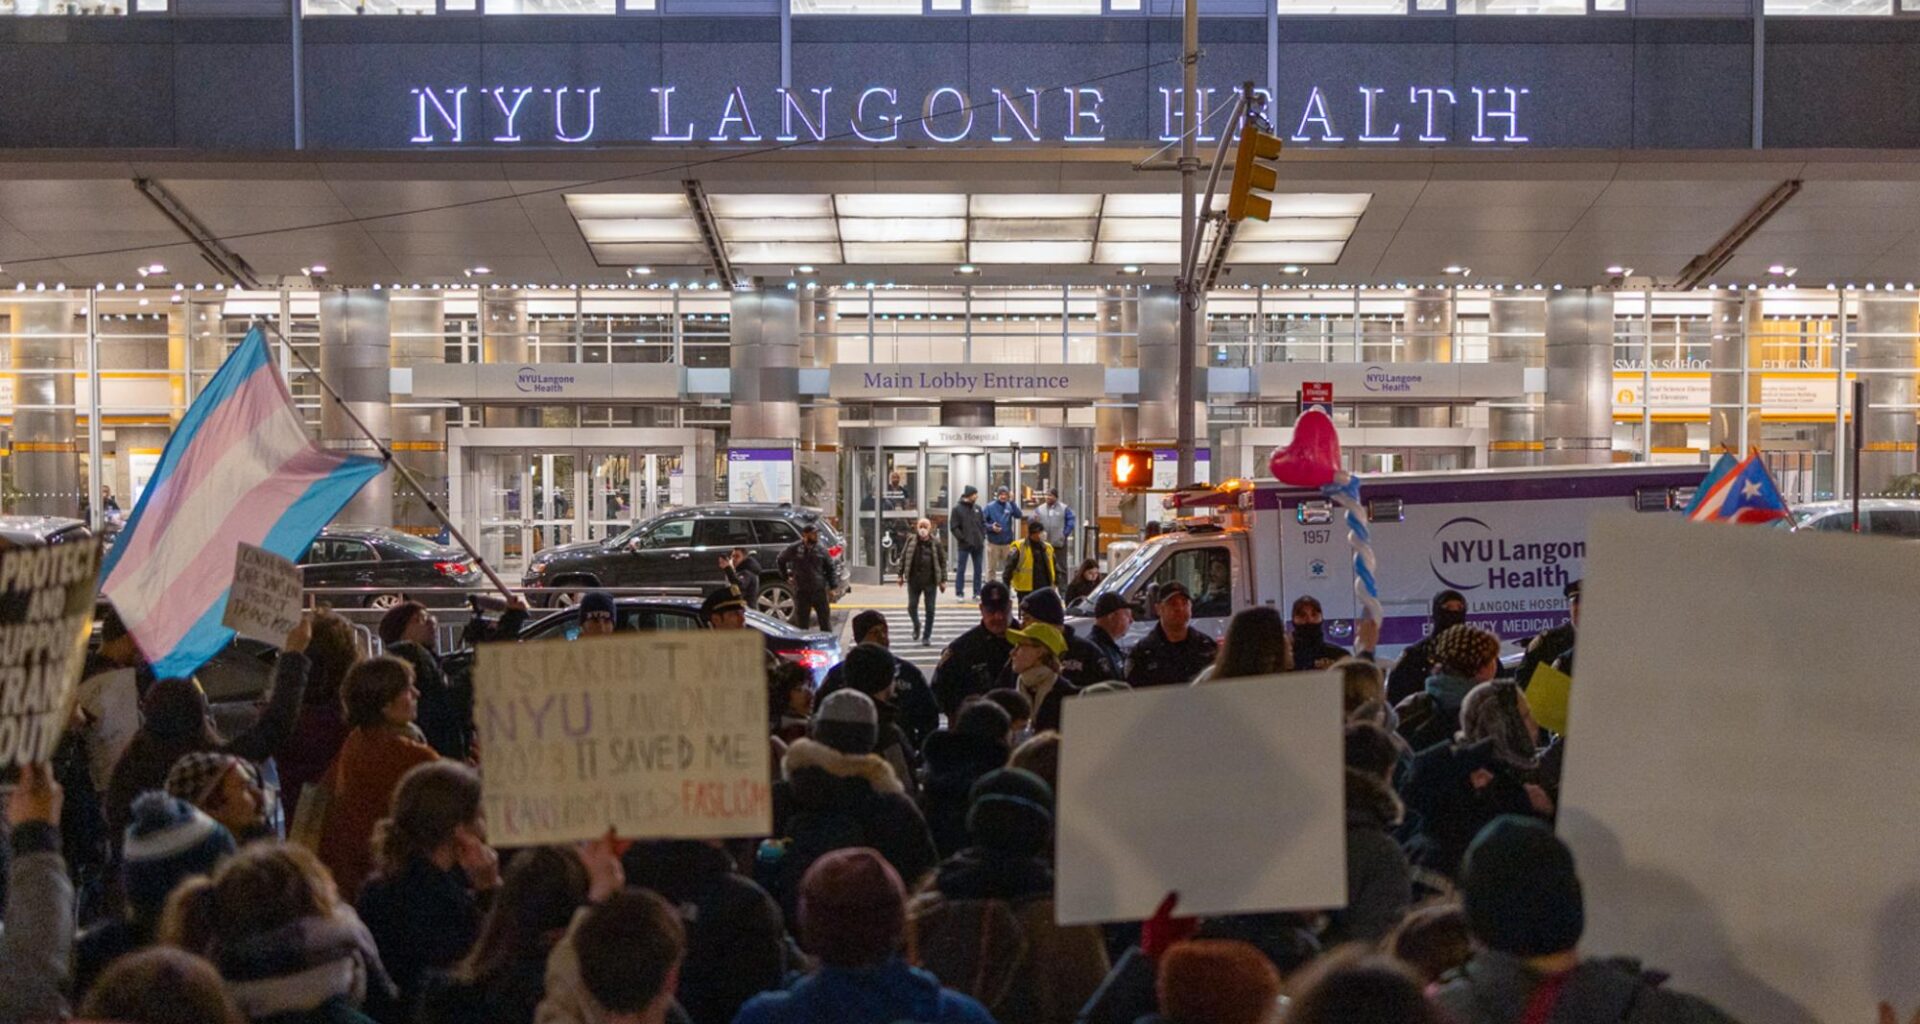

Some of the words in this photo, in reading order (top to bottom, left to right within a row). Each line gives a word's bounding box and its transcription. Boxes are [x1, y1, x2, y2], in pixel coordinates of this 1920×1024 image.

[410, 86, 600, 142] NYU
[650, 86, 1105, 142] LANGONE
[534, 384, 563, 392] Health
[864, 372, 913, 389] Main
[919, 371, 978, 392] Lobby
[983, 372, 1069, 389] Entrance
[1382, 383, 1410, 391] Health
[1303, 530, 1330, 544] 1957
[1442, 540, 1493, 563] NYU
[1499, 539, 1586, 564] Langon
[1, 539, 97, 594] PROTECT
[1488, 564, 1568, 589] Health
[27, 586, 66, 621] AND
[1473, 600, 1526, 613] LANGONE
[1502, 619, 1555, 633] MEDICAL
[512, 641, 647, 690] STARTED
[651, 641, 688, 679] T
[483, 690, 593, 744] NYU
[604, 682, 731, 735] LANGONE
[486, 741, 568, 788] 2023
[574, 738, 600, 781] IT
[607, 733, 694, 775] SAVED
[705, 732, 751, 770] ME
